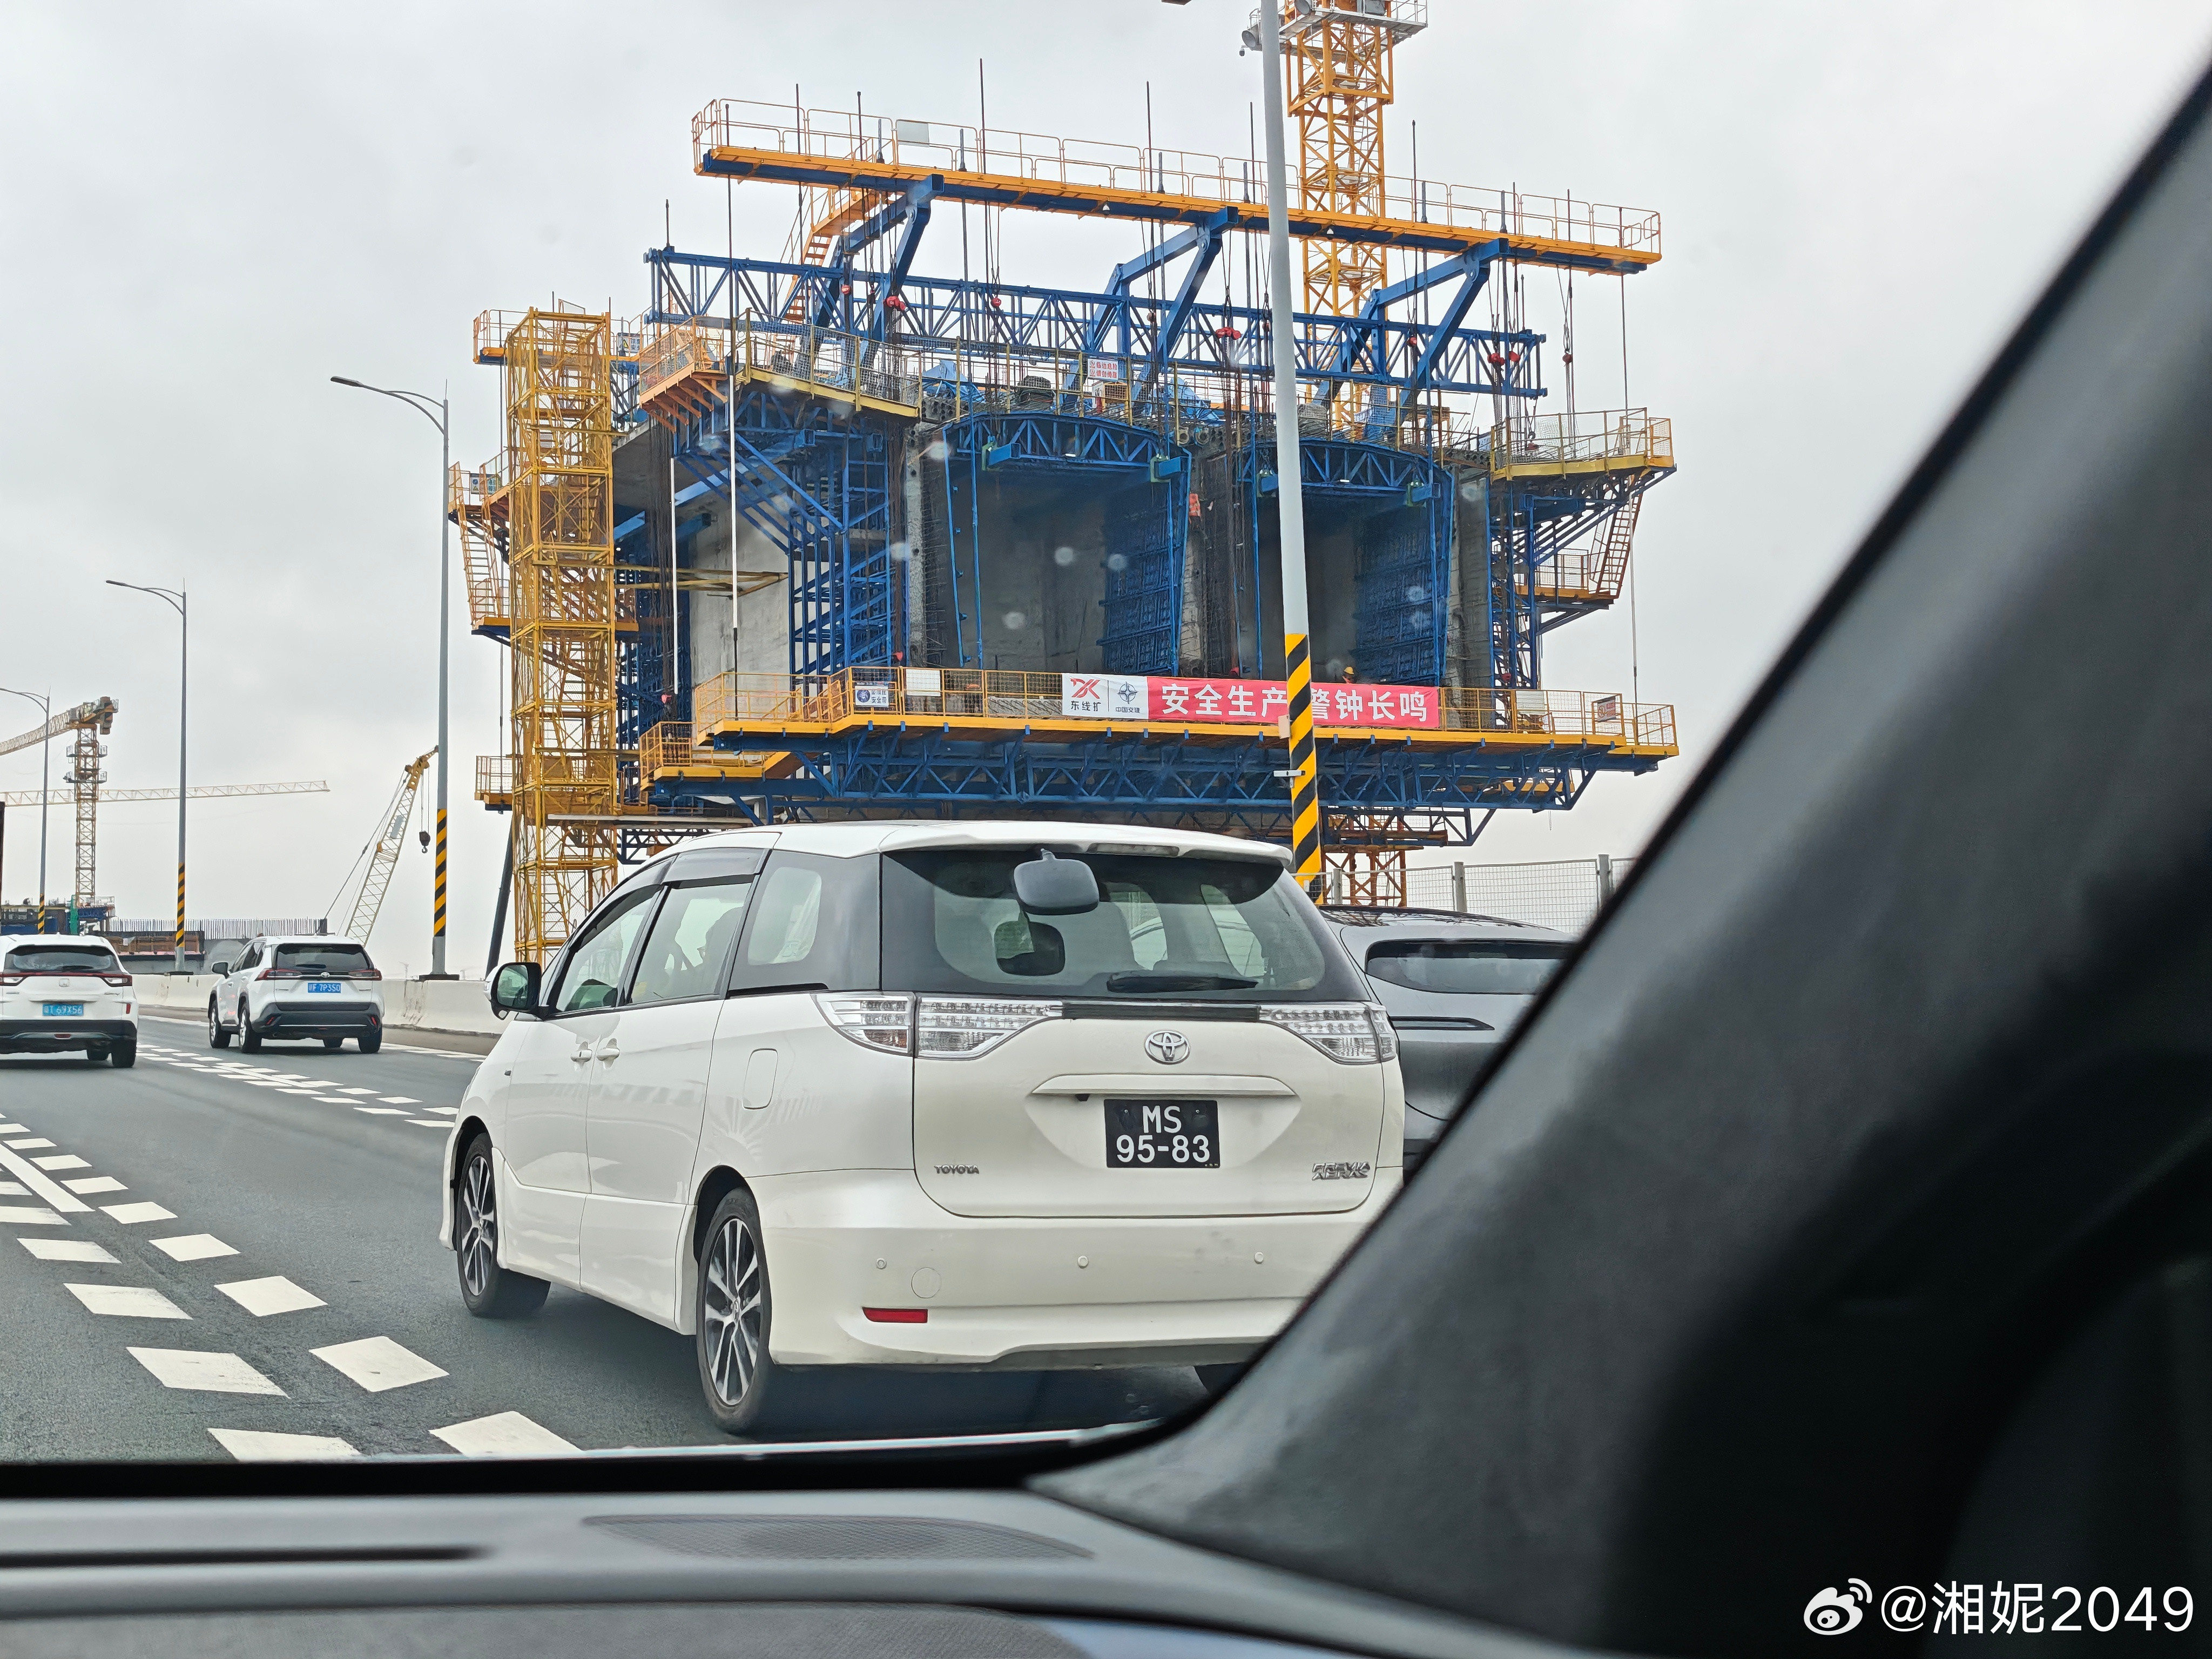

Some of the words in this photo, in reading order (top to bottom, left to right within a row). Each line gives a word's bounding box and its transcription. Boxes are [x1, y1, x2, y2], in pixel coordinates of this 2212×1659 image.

[1071, 700, 1102, 712] 东线扩
[1142, 1105, 1182, 1134] MS
[1116, 1134, 1210, 1163] 95-83
[934, 1164, 980, 1174] TOYOTA
